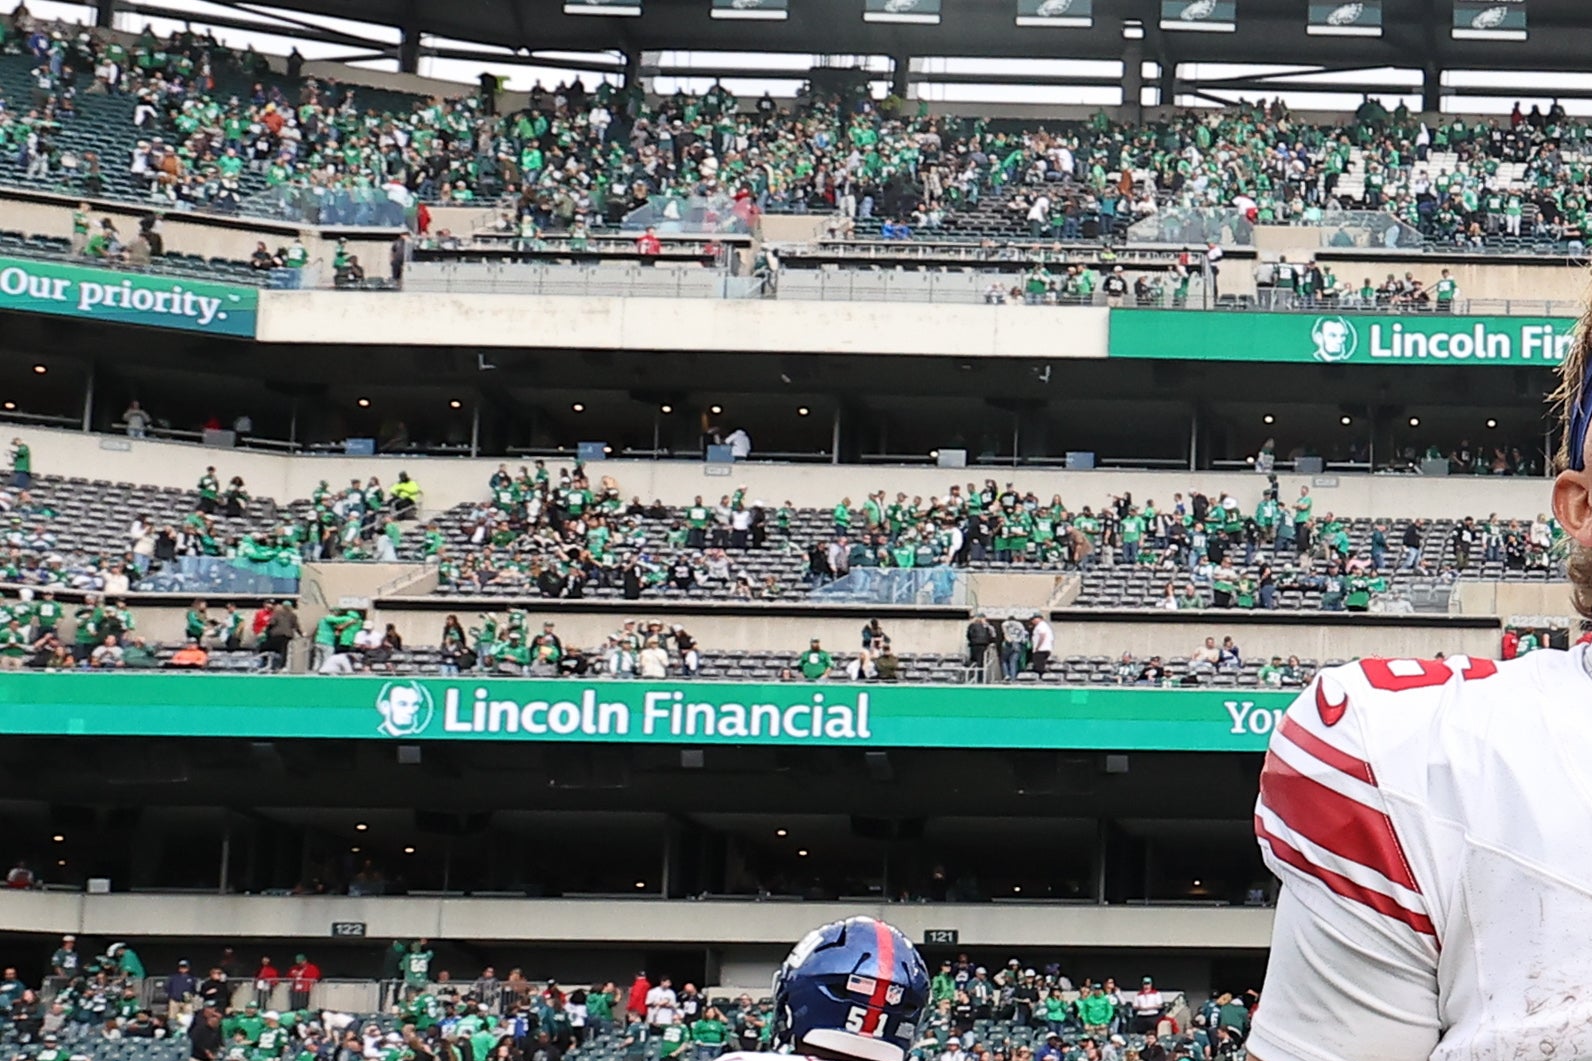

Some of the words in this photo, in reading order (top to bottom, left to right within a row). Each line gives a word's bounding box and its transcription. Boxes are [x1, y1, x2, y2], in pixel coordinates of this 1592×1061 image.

[1, 267, 72, 301] Our
[78, 280, 227, 324] priority.
[1370, 323, 1511, 359] Lincoln
[444, 687, 629, 735] Lincoln
[643, 690, 872, 739] Financial
[336, 924, 363, 935] 122
[929, 931, 953, 943] 121
[845, 1005, 889, 1038] 51
